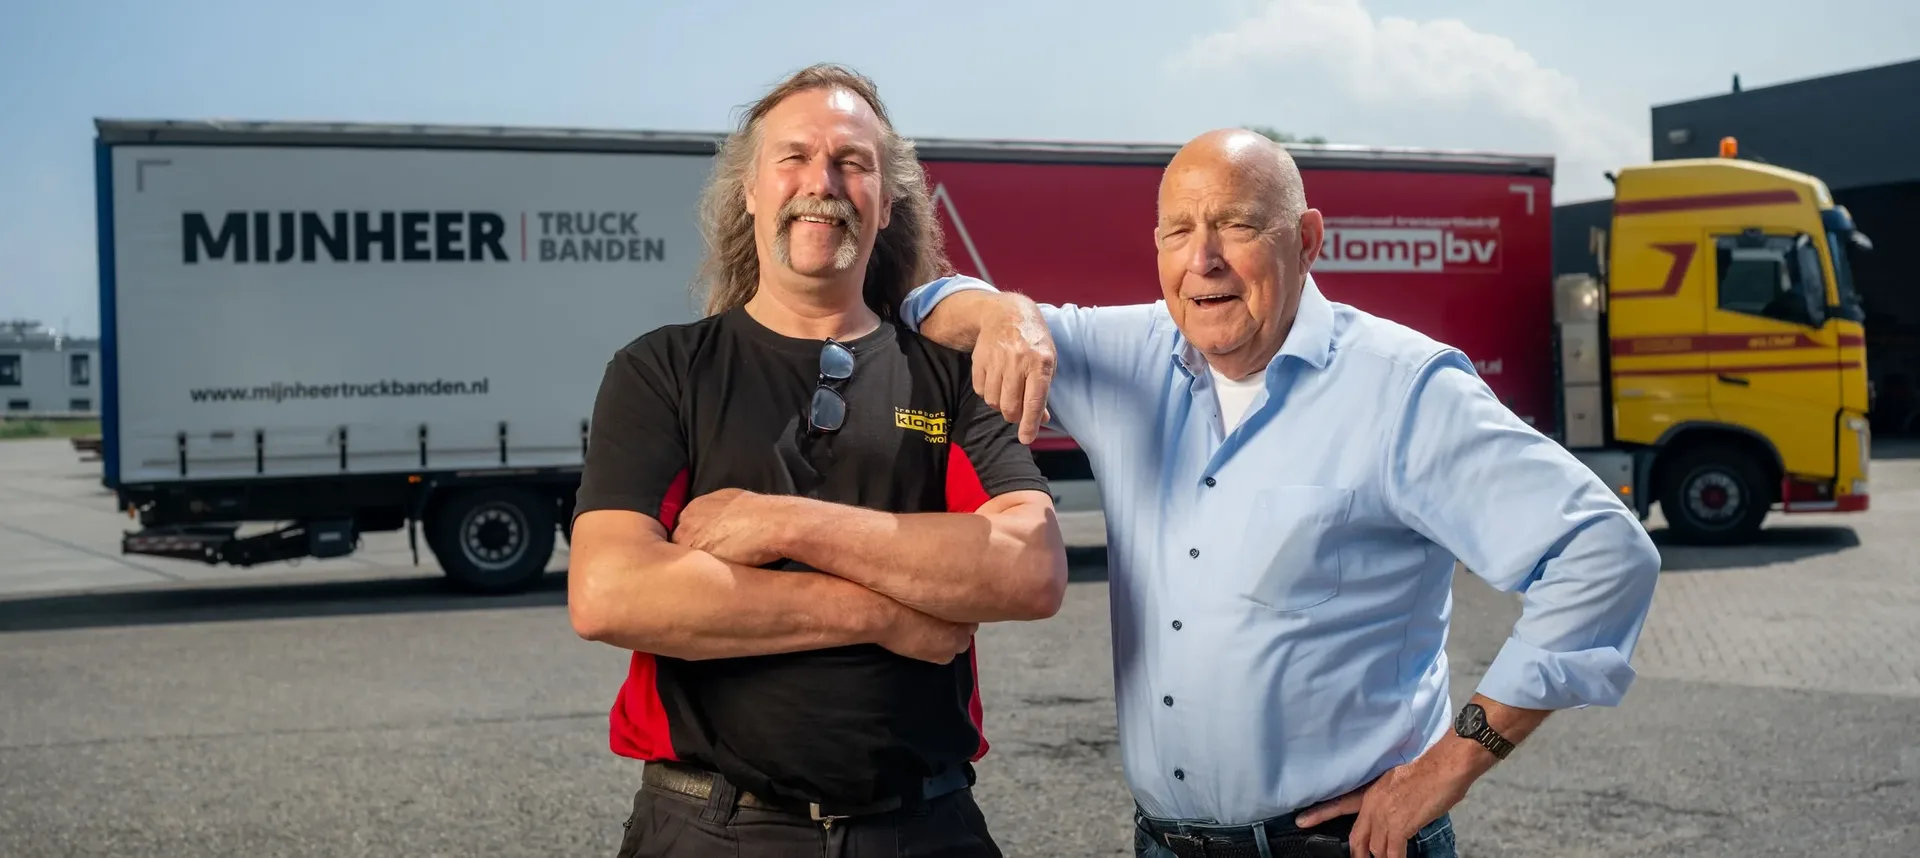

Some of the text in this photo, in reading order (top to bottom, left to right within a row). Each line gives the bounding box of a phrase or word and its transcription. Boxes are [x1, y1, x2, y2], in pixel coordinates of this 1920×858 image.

[538, 211, 640, 236] TRUCK
[182, 210, 510, 265] MIJNHEER
[538, 238, 666, 263] BANDEN
[189, 377, 489, 403] www.mijnheertruckbanden.nl
